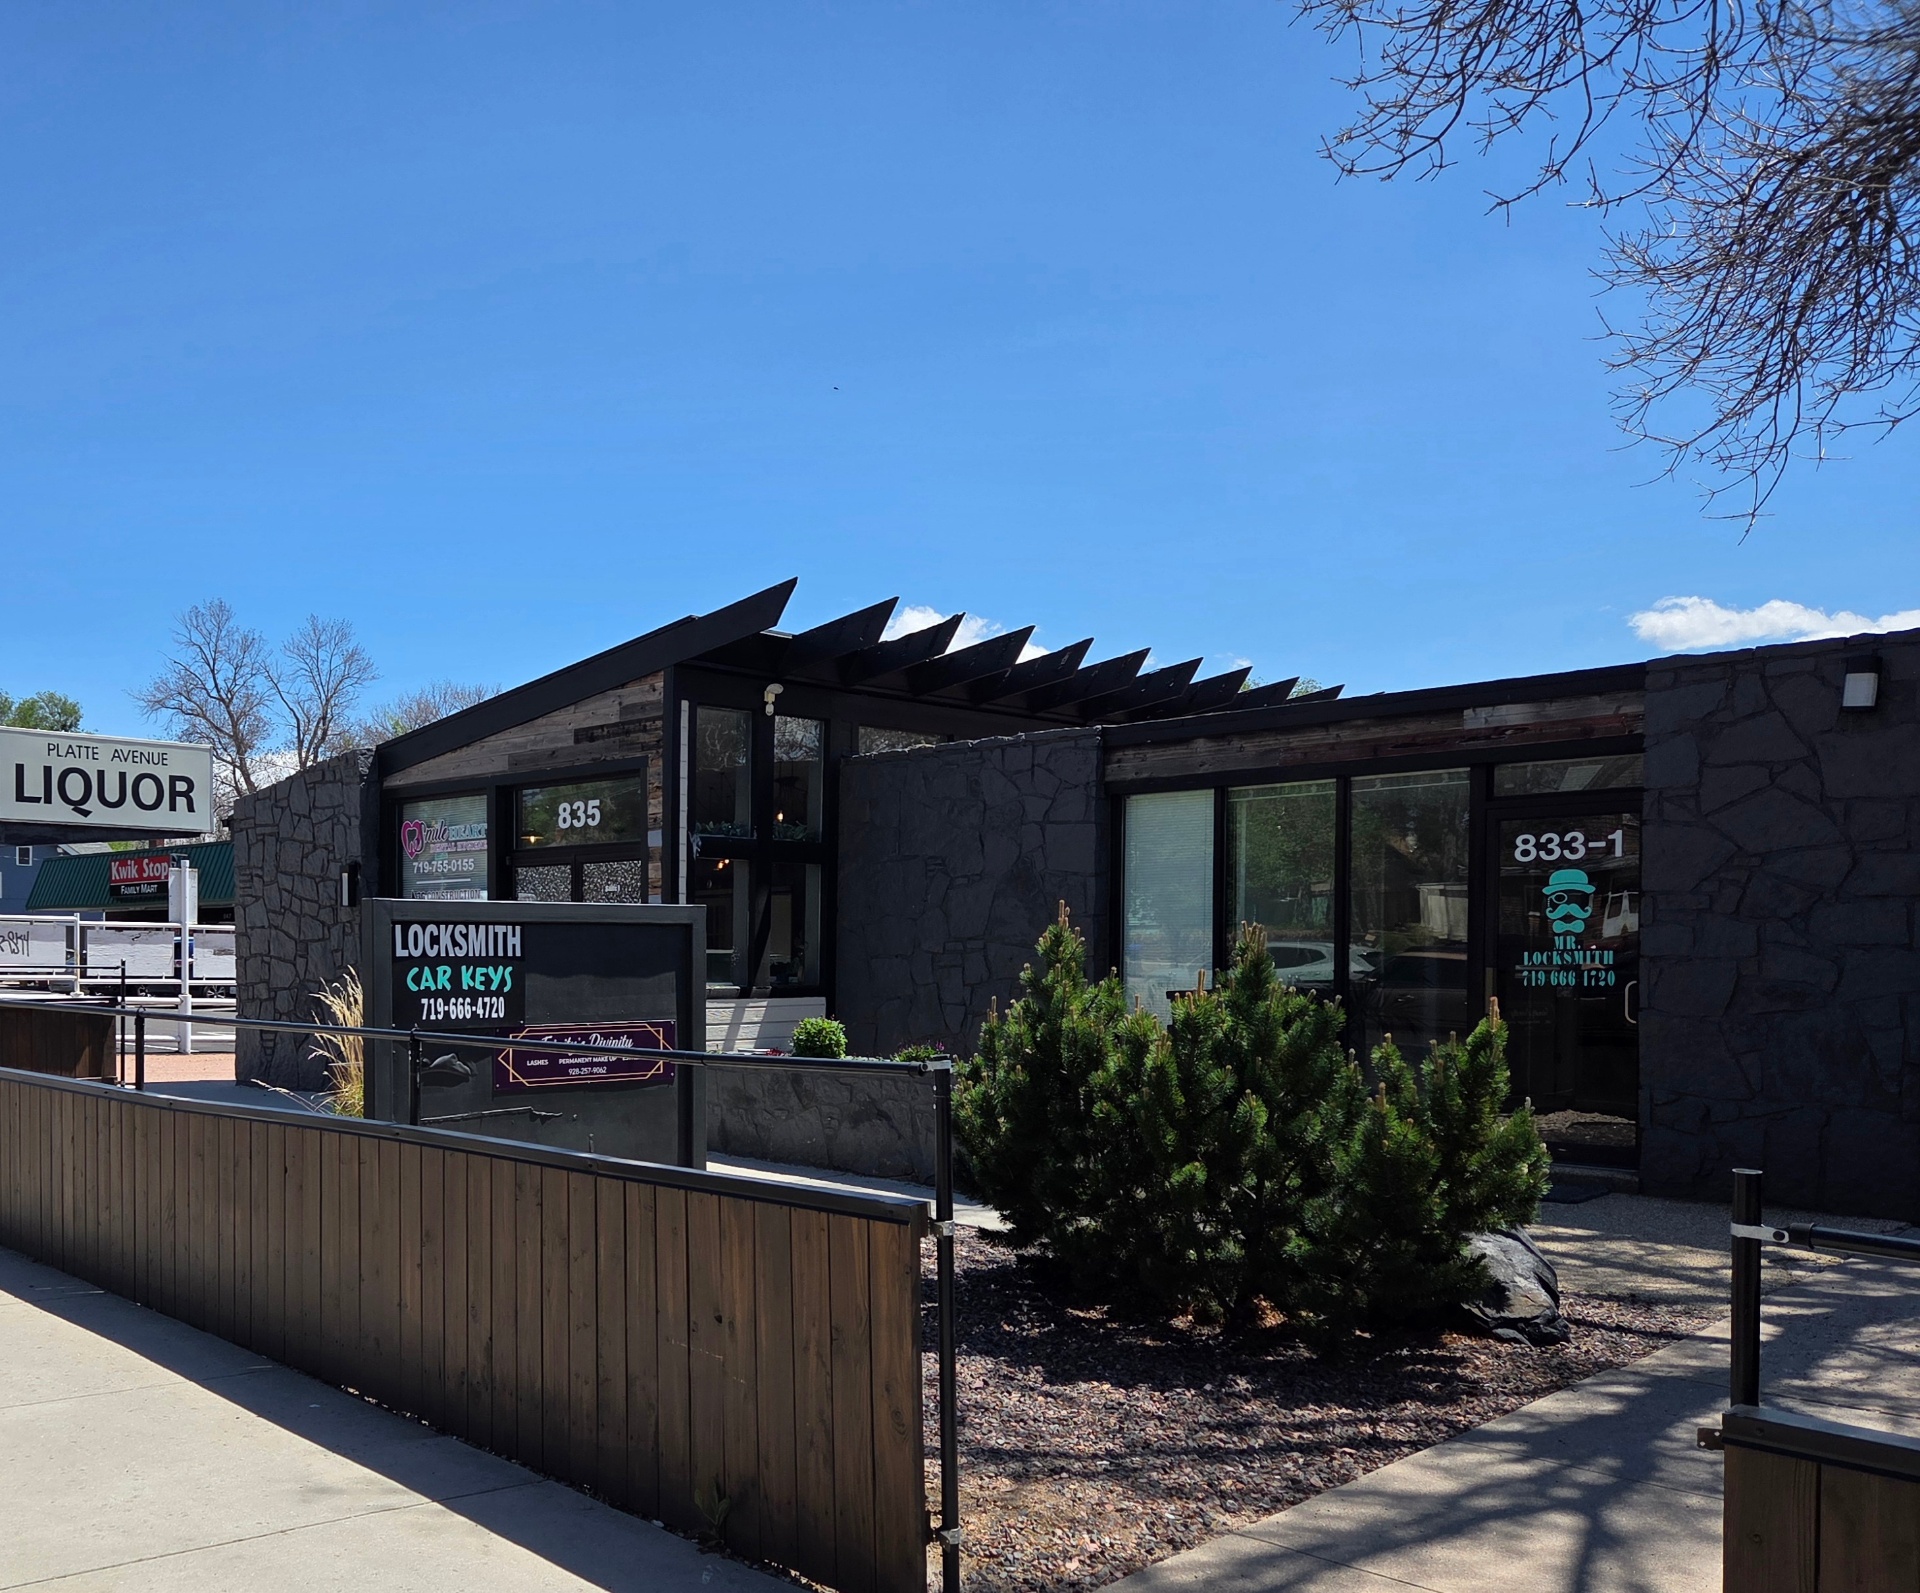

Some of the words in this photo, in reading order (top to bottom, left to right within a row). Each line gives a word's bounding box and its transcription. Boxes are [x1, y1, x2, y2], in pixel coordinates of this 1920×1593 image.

[47, 742, 99, 761] PLATTE
[110, 748, 168, 766] AVENUE
[15, 763, 196, 818] LIQUOR
[558, 799, 601, 829] 835
[448, 823, 487, 841] HEART
[1514, 829, 1623, 863] 833-1
[111, 860, 139, 880] Kwik
[142, 858, 169, 879] Stop
[412, 858, 475, 874] 719-755-0155
[120, 885, 140, 895] FAMILY
[140, 884, 159, 893] MART
[395, 924, 522, 957] LOCKSMITH
[1553, 935, 1581, 950] MR.
[1523, 951, 1614, 966] LOCKSMITH
[406, 965, 452, 992] CAR
[461, 965, 513, 993] KEYS
[421, 996, 505, 1020] 719-666-4720
[526, 1059, 549, 1067] LASHES
[558, 1057, 593, 1065] PERMANENT
[568, 1066, 608, 1076] 928-257-9062
